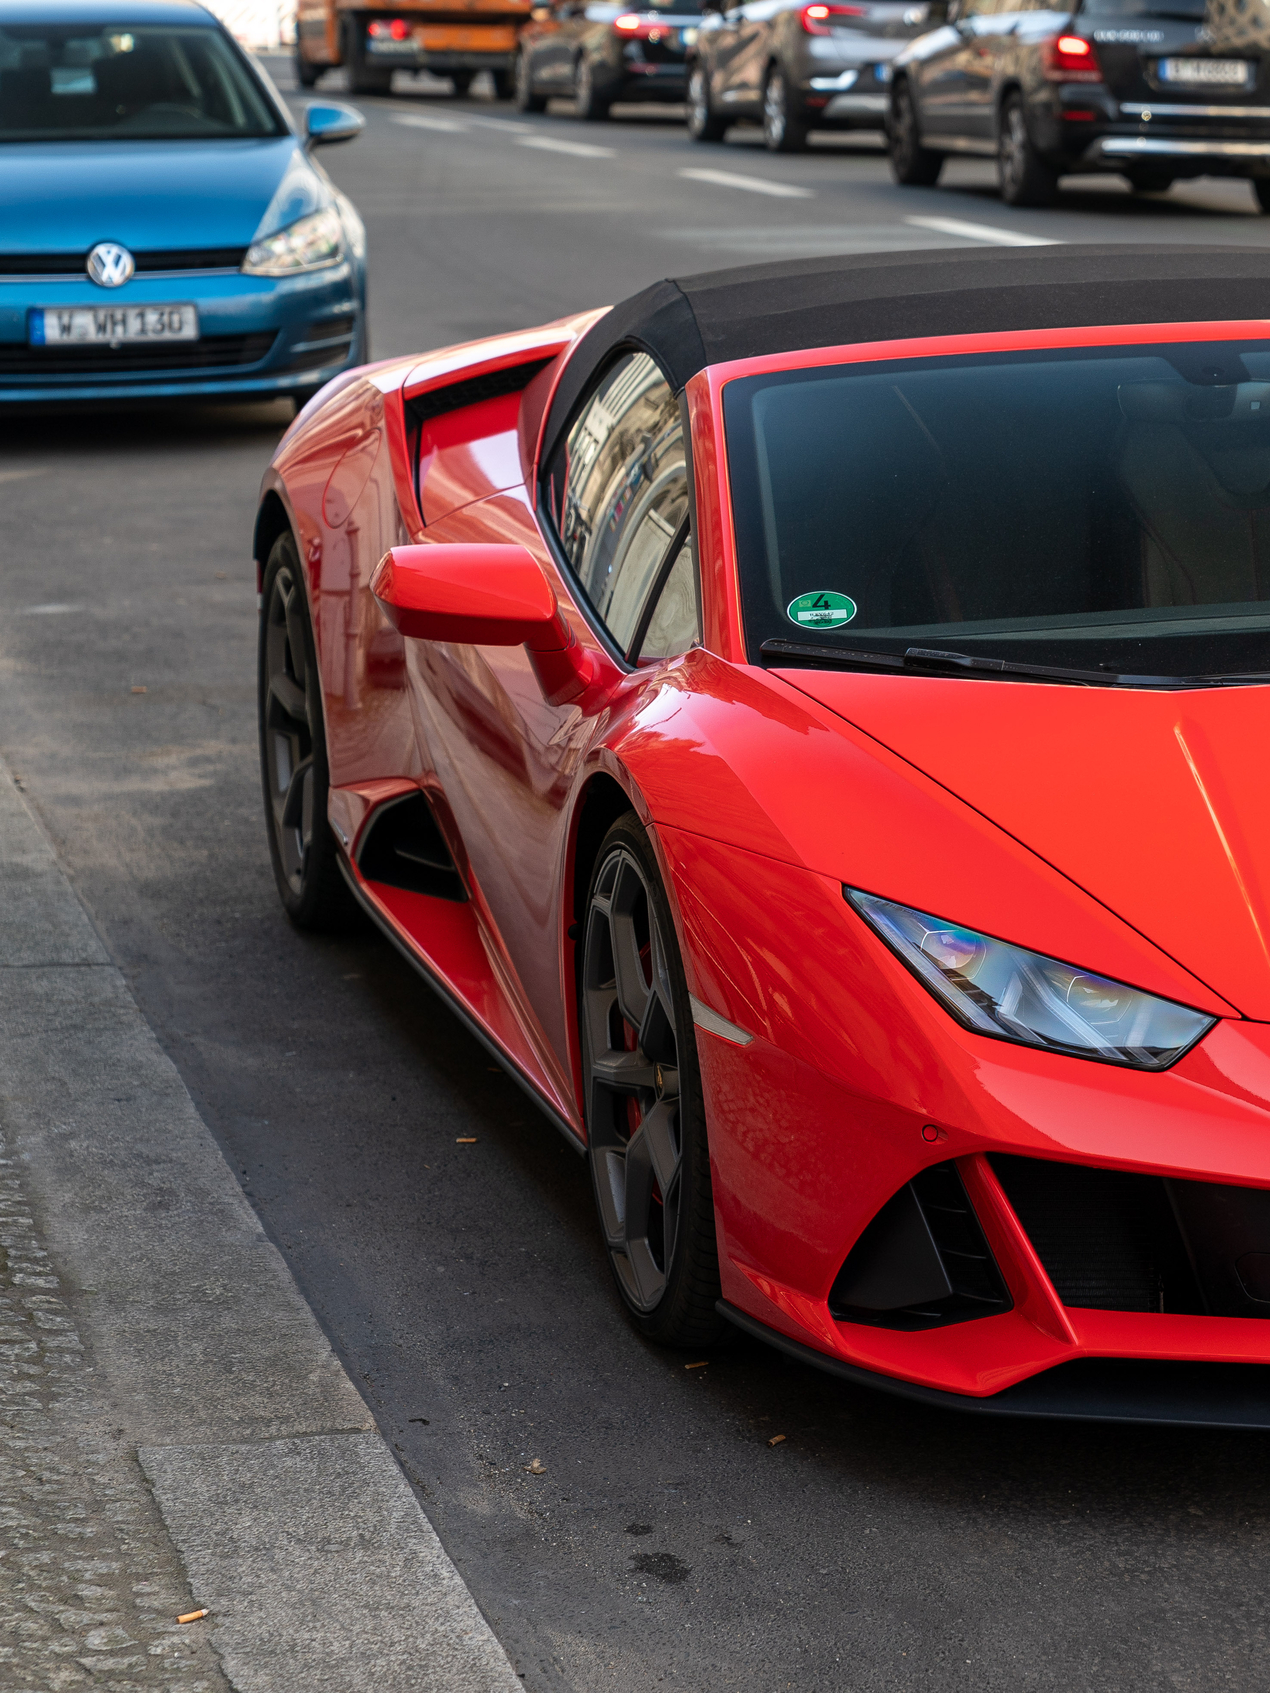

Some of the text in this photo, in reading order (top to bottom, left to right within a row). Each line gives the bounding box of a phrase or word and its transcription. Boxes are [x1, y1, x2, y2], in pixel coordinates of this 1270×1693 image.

[57, 310, 183, 339] W WH 130
[812, 593, 831, 609] 4
